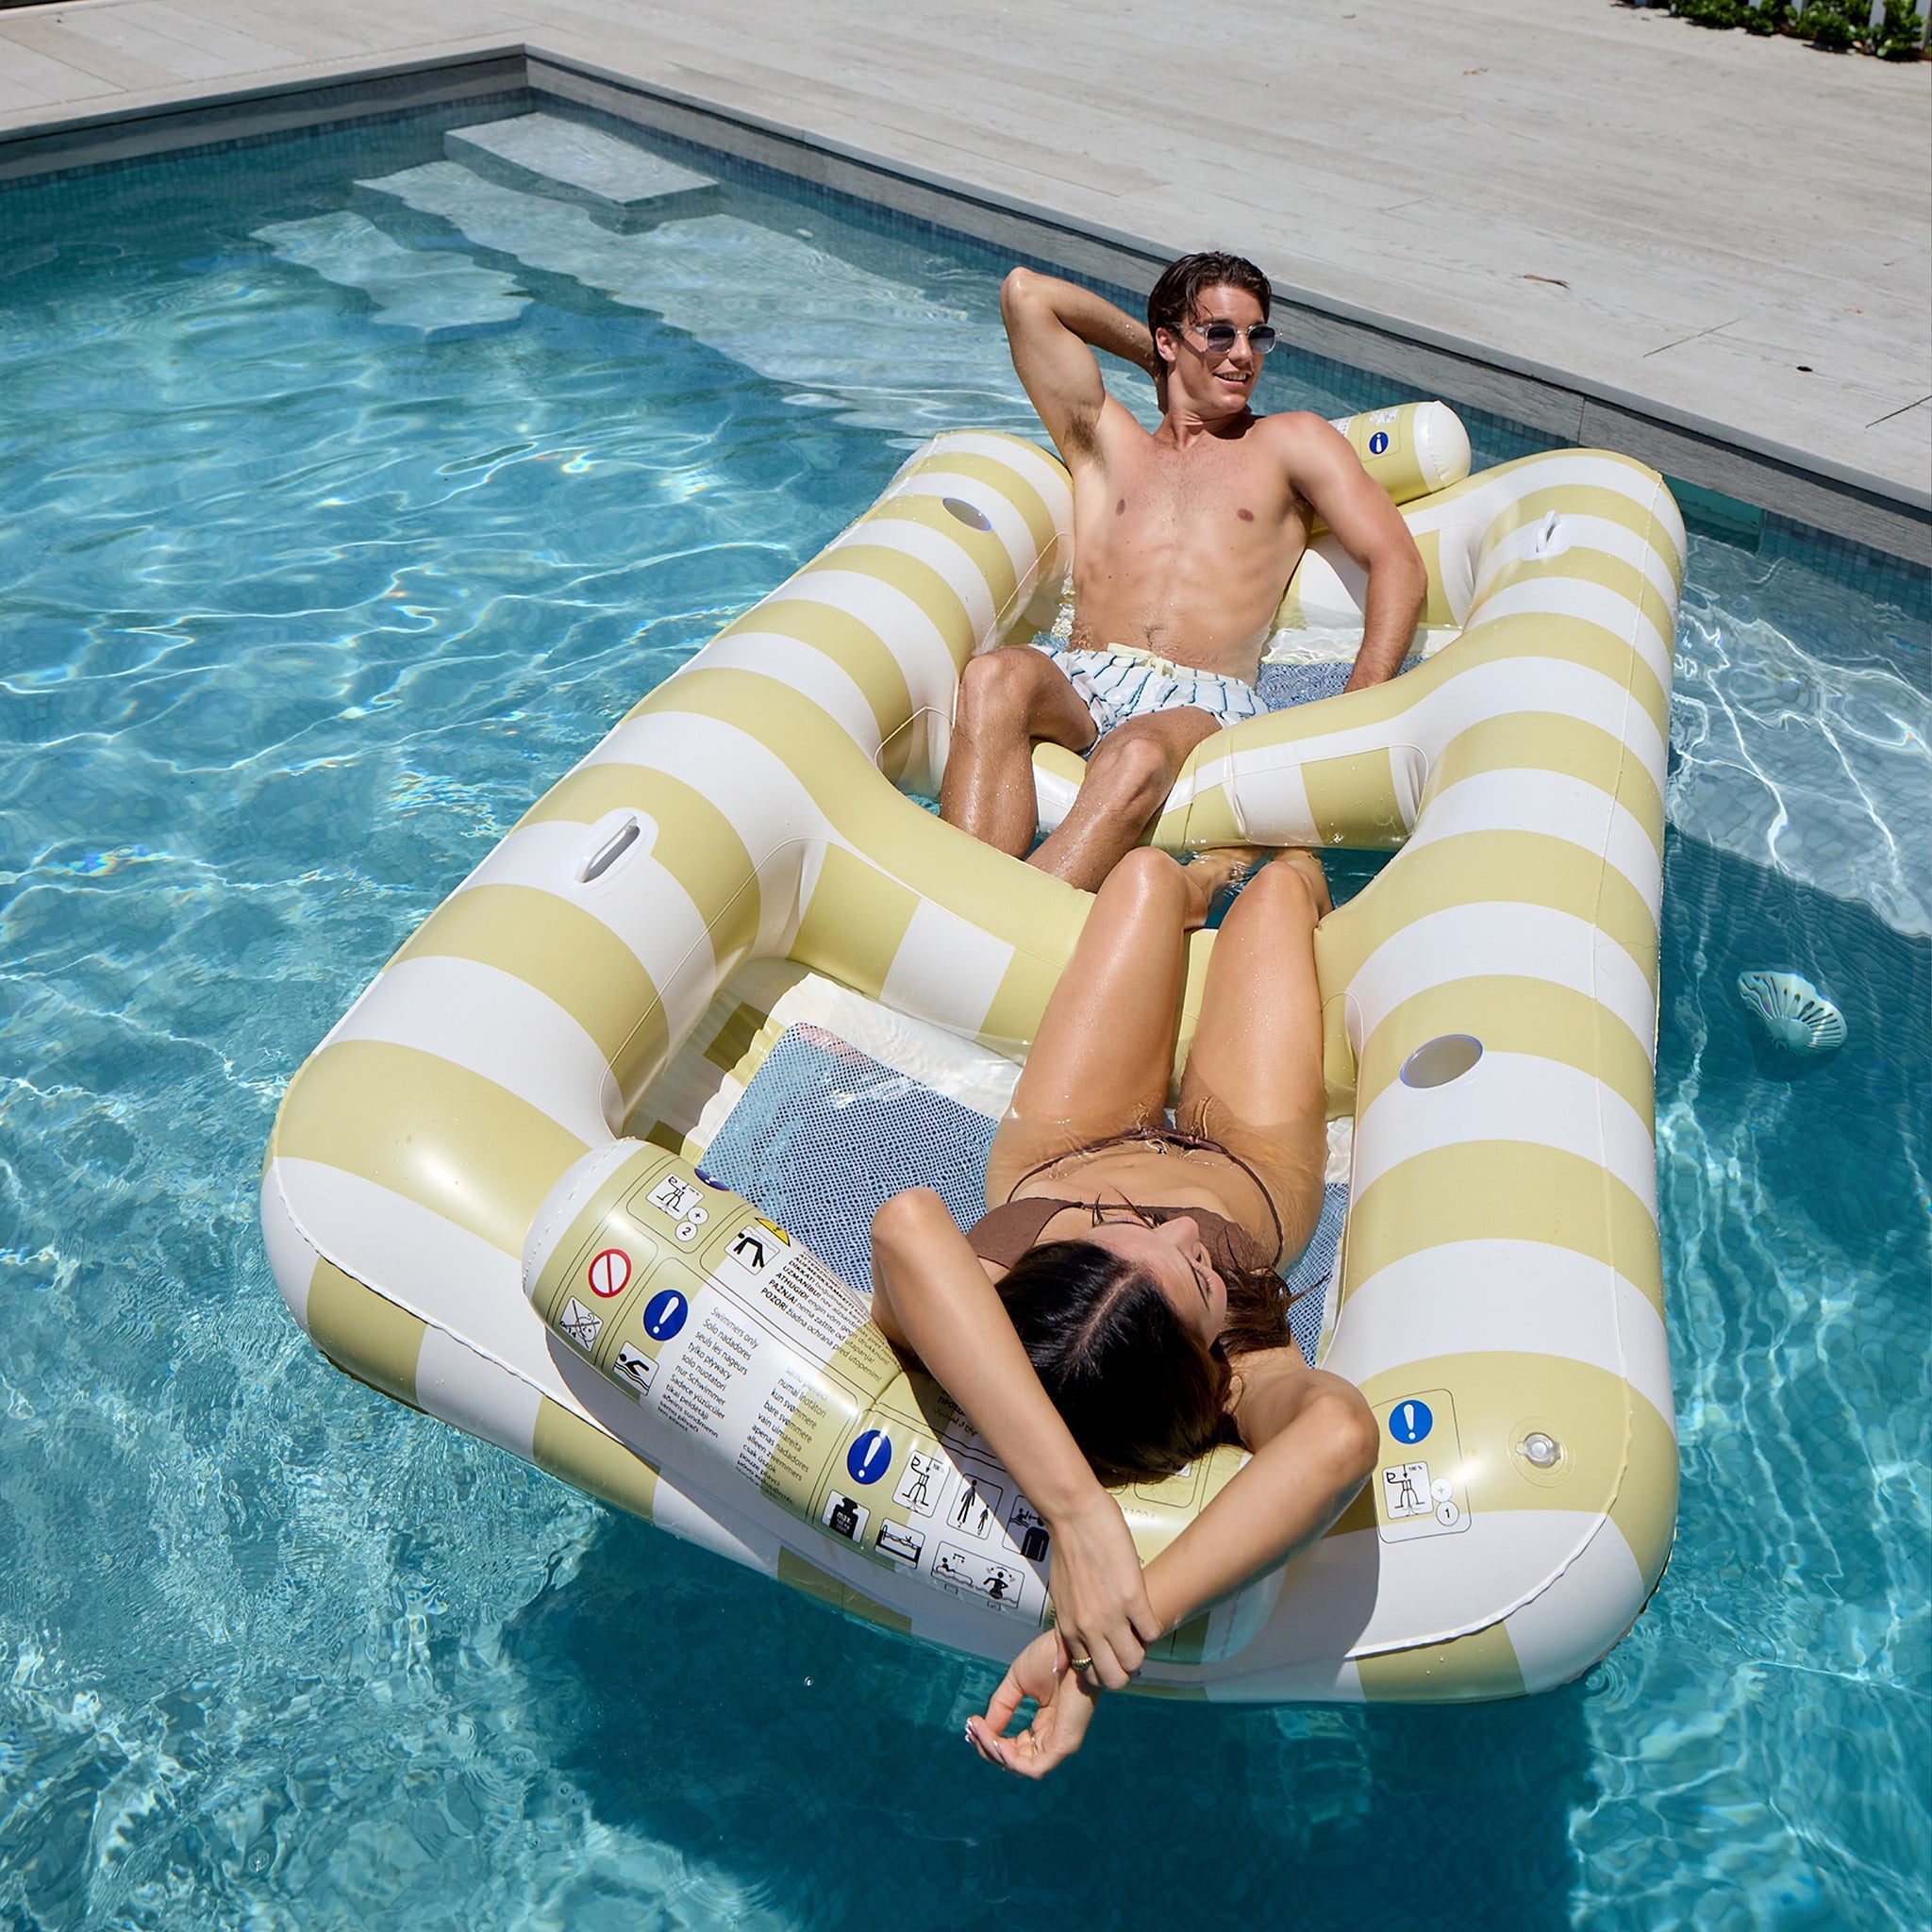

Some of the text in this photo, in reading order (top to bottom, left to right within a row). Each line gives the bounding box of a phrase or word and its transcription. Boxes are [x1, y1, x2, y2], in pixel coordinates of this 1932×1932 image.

[682, 1226, 691, 1237] 2
[760, 1287, 788, 1311] POZOR!
[807, 1323, 833, 1348] ochrana
[832, 1343, 850, 1358] pred
[797, 1301, 814, 1318] nema
[835, 1331, 846, 1341] od
[808, 1298, 826, 1316] engin
[703, 1318, 752, 1361] Solo nadadores
[711, 1307, 759, 1349] Swimmers only
[688, 1342, 705, 1359] tylko
[695, 1331, 749, 1376] seuls les nageurs
[670, 1374, 693, 1396] Sadece
[675, 1364, 726, 1406] nur Schwimmer
[681, 1354, 726, 1392] solo nuotatori
[777, 1377, 800, 1397] numai
[763, 1400, 779, 1418] bare
[771, 1388, 784, 1404] kun
[752, 1424, 809, 1473] apenas nadadores
[758, 1413, 802, 1453] vain uimareita
[746, 1435, 803, 1481] alleen zwemmers
